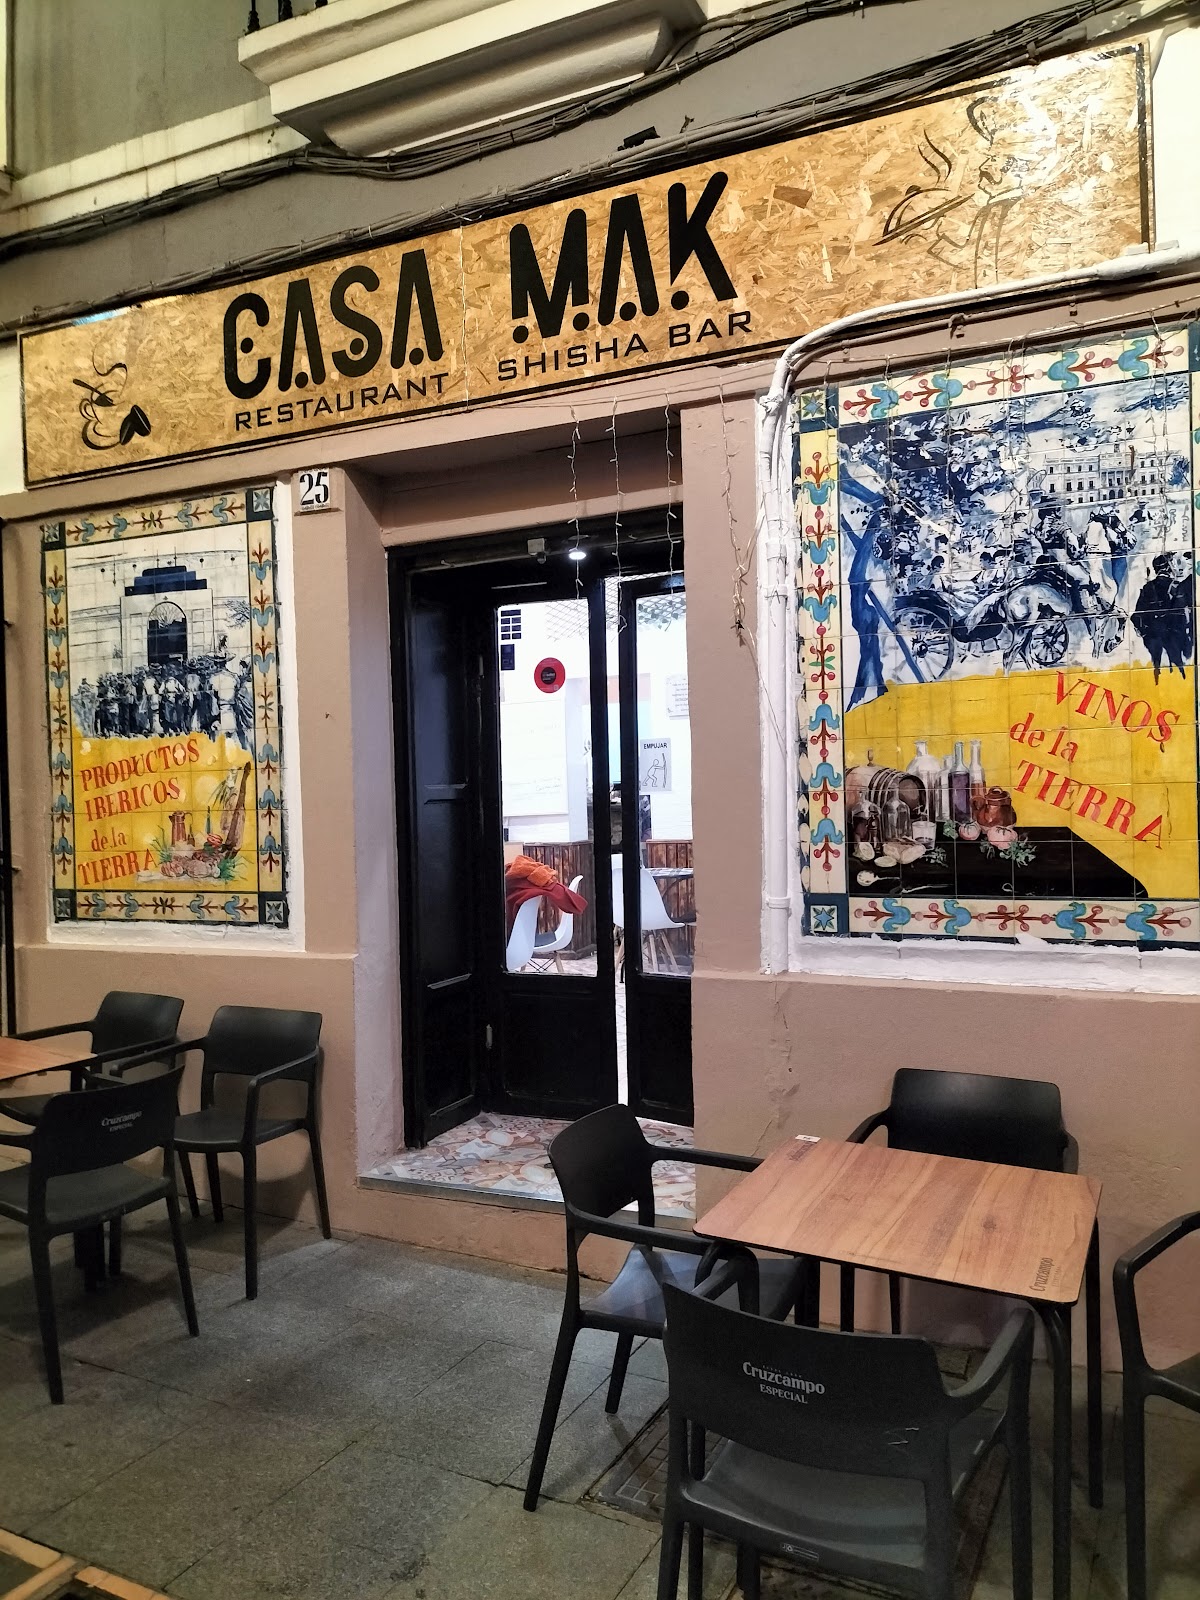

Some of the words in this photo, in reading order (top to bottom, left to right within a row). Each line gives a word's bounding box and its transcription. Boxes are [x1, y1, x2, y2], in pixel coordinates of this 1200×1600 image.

[223, 248, 445, 400] CASA
[509, 171, 738, 345] MAK
[235, 373, 449, 432] RESTAURANT
[498, 332, 648, 381] SHISHA
[668, 310, 753, 348] BAR
[299, 471, 329, 506] 25
[1055, 671, 1180, 744] VINOS
[643, 742, 668, 750] EMPUJAR
[1009, 712, 1045, 748] de
[1047, 726, 1079, 763] la
[80, 738, 200, 792] PRODUCTOS
[84, 776, 181, 822] IBERICOS
[1013, 759, 1163, 850] TIERRA
[90, 829, 110, 852] de
[113, 826, 127, 846] la
[78, 848, 157, 886] TIERRA
[1029, 1257, 1055, 1292] Cruzcampo
[742, 1361, 826, 1395] Cruzcampo
[759, 1383, 808, 1404] ESPECIAL
